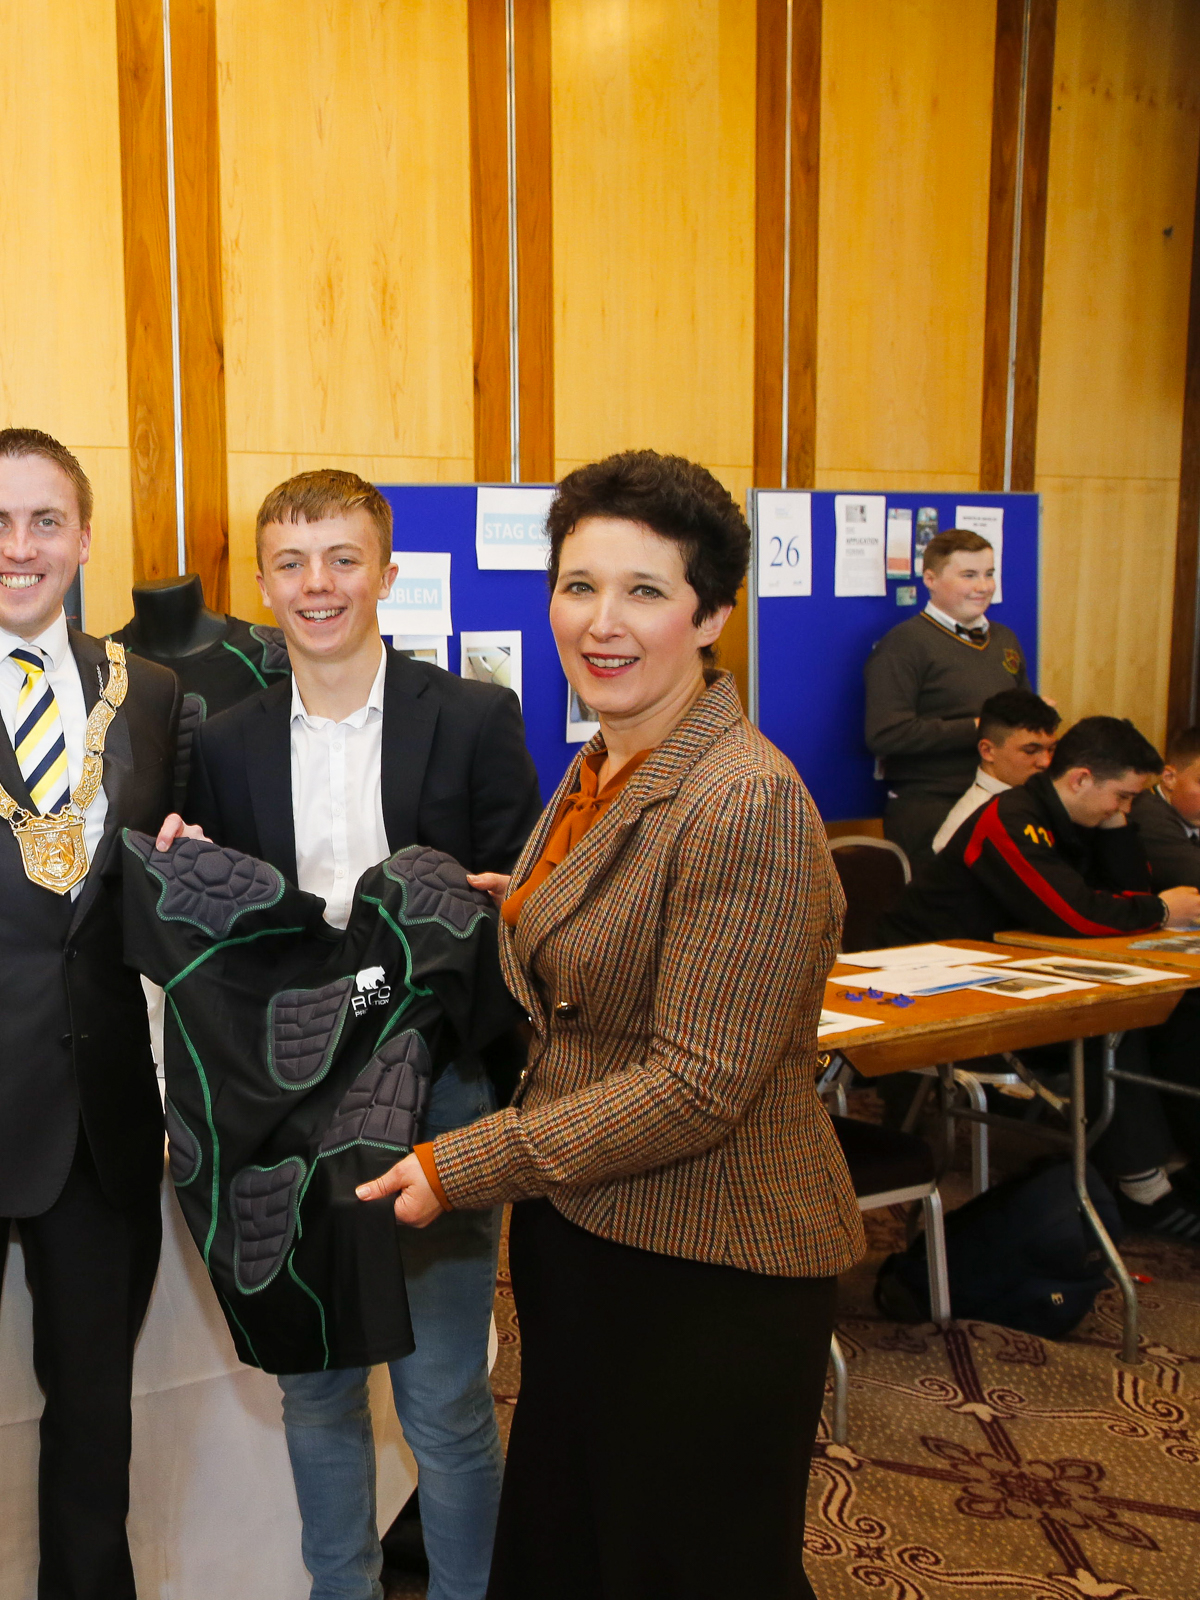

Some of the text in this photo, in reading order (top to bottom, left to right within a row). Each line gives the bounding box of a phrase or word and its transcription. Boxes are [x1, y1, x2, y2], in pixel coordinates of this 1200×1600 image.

[484, 522, 549, 540] STAG CL
[769, 535, 800, 568] 26
[384, 587, 439, 605] OBLEM
